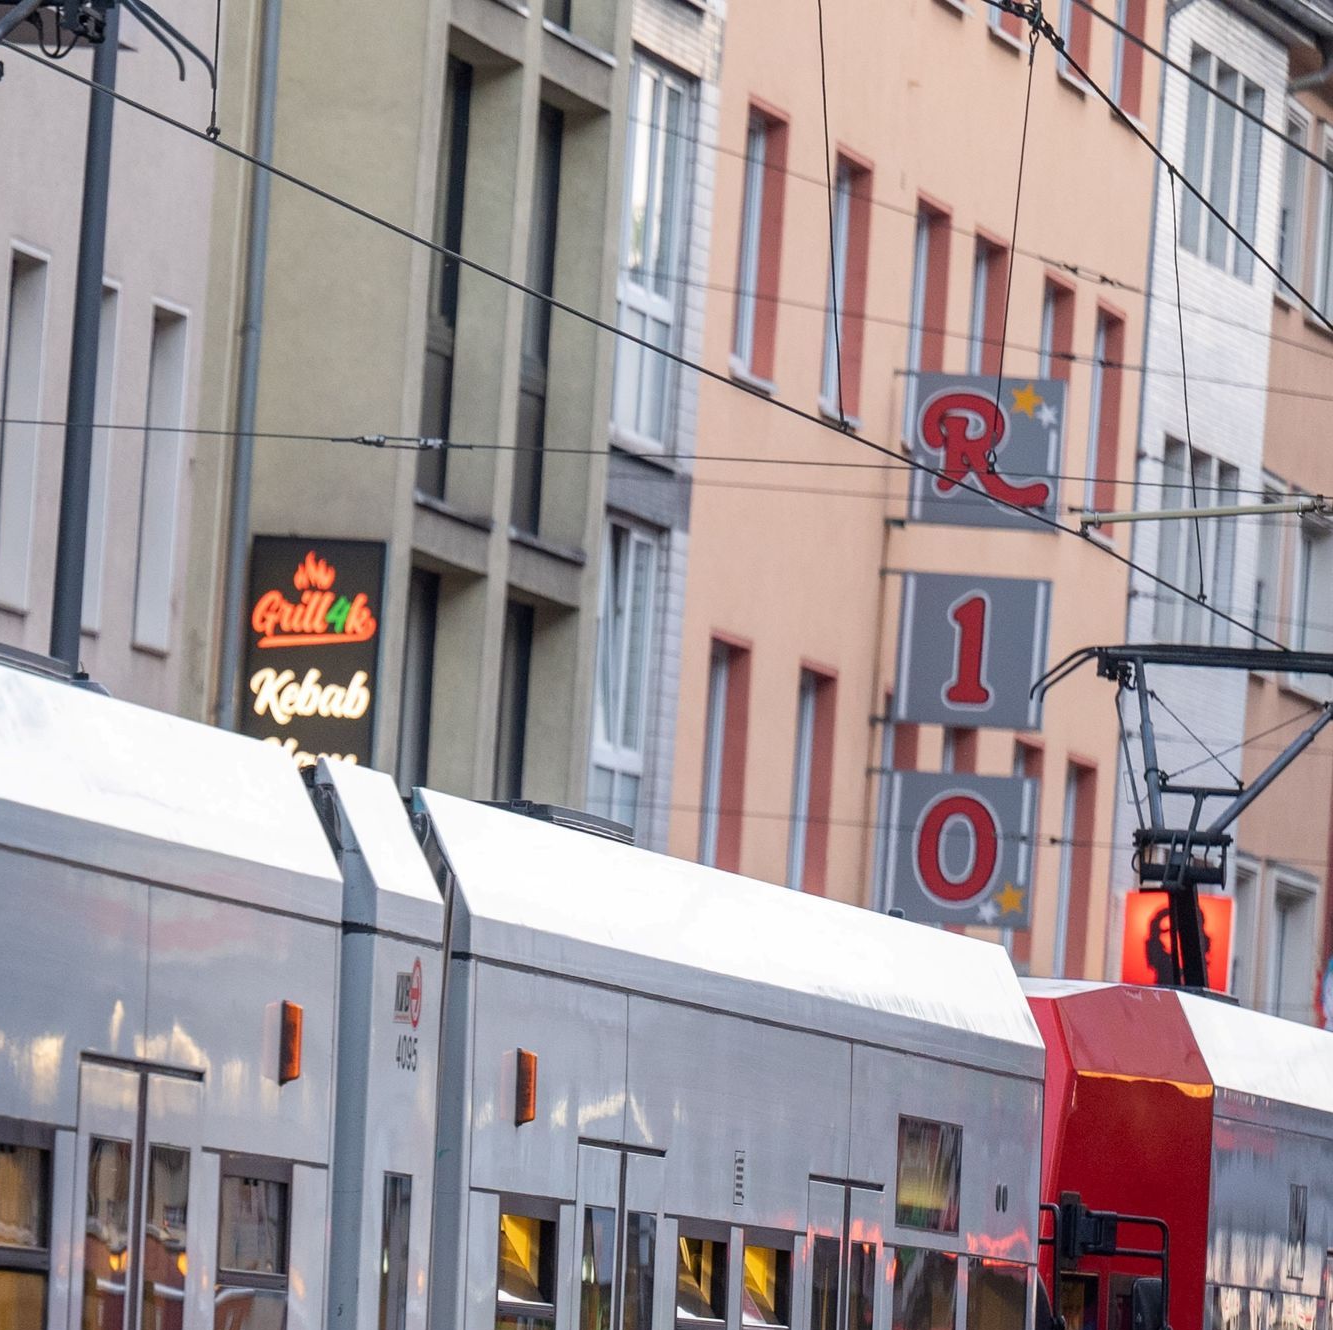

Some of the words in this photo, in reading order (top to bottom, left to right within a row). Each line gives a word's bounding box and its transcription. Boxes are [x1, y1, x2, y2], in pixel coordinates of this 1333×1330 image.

[251, 589, 377, 642] Grill4k
[250, 667, 371, 725] Kebab
[395, 1034, 418, 1072] 4095
